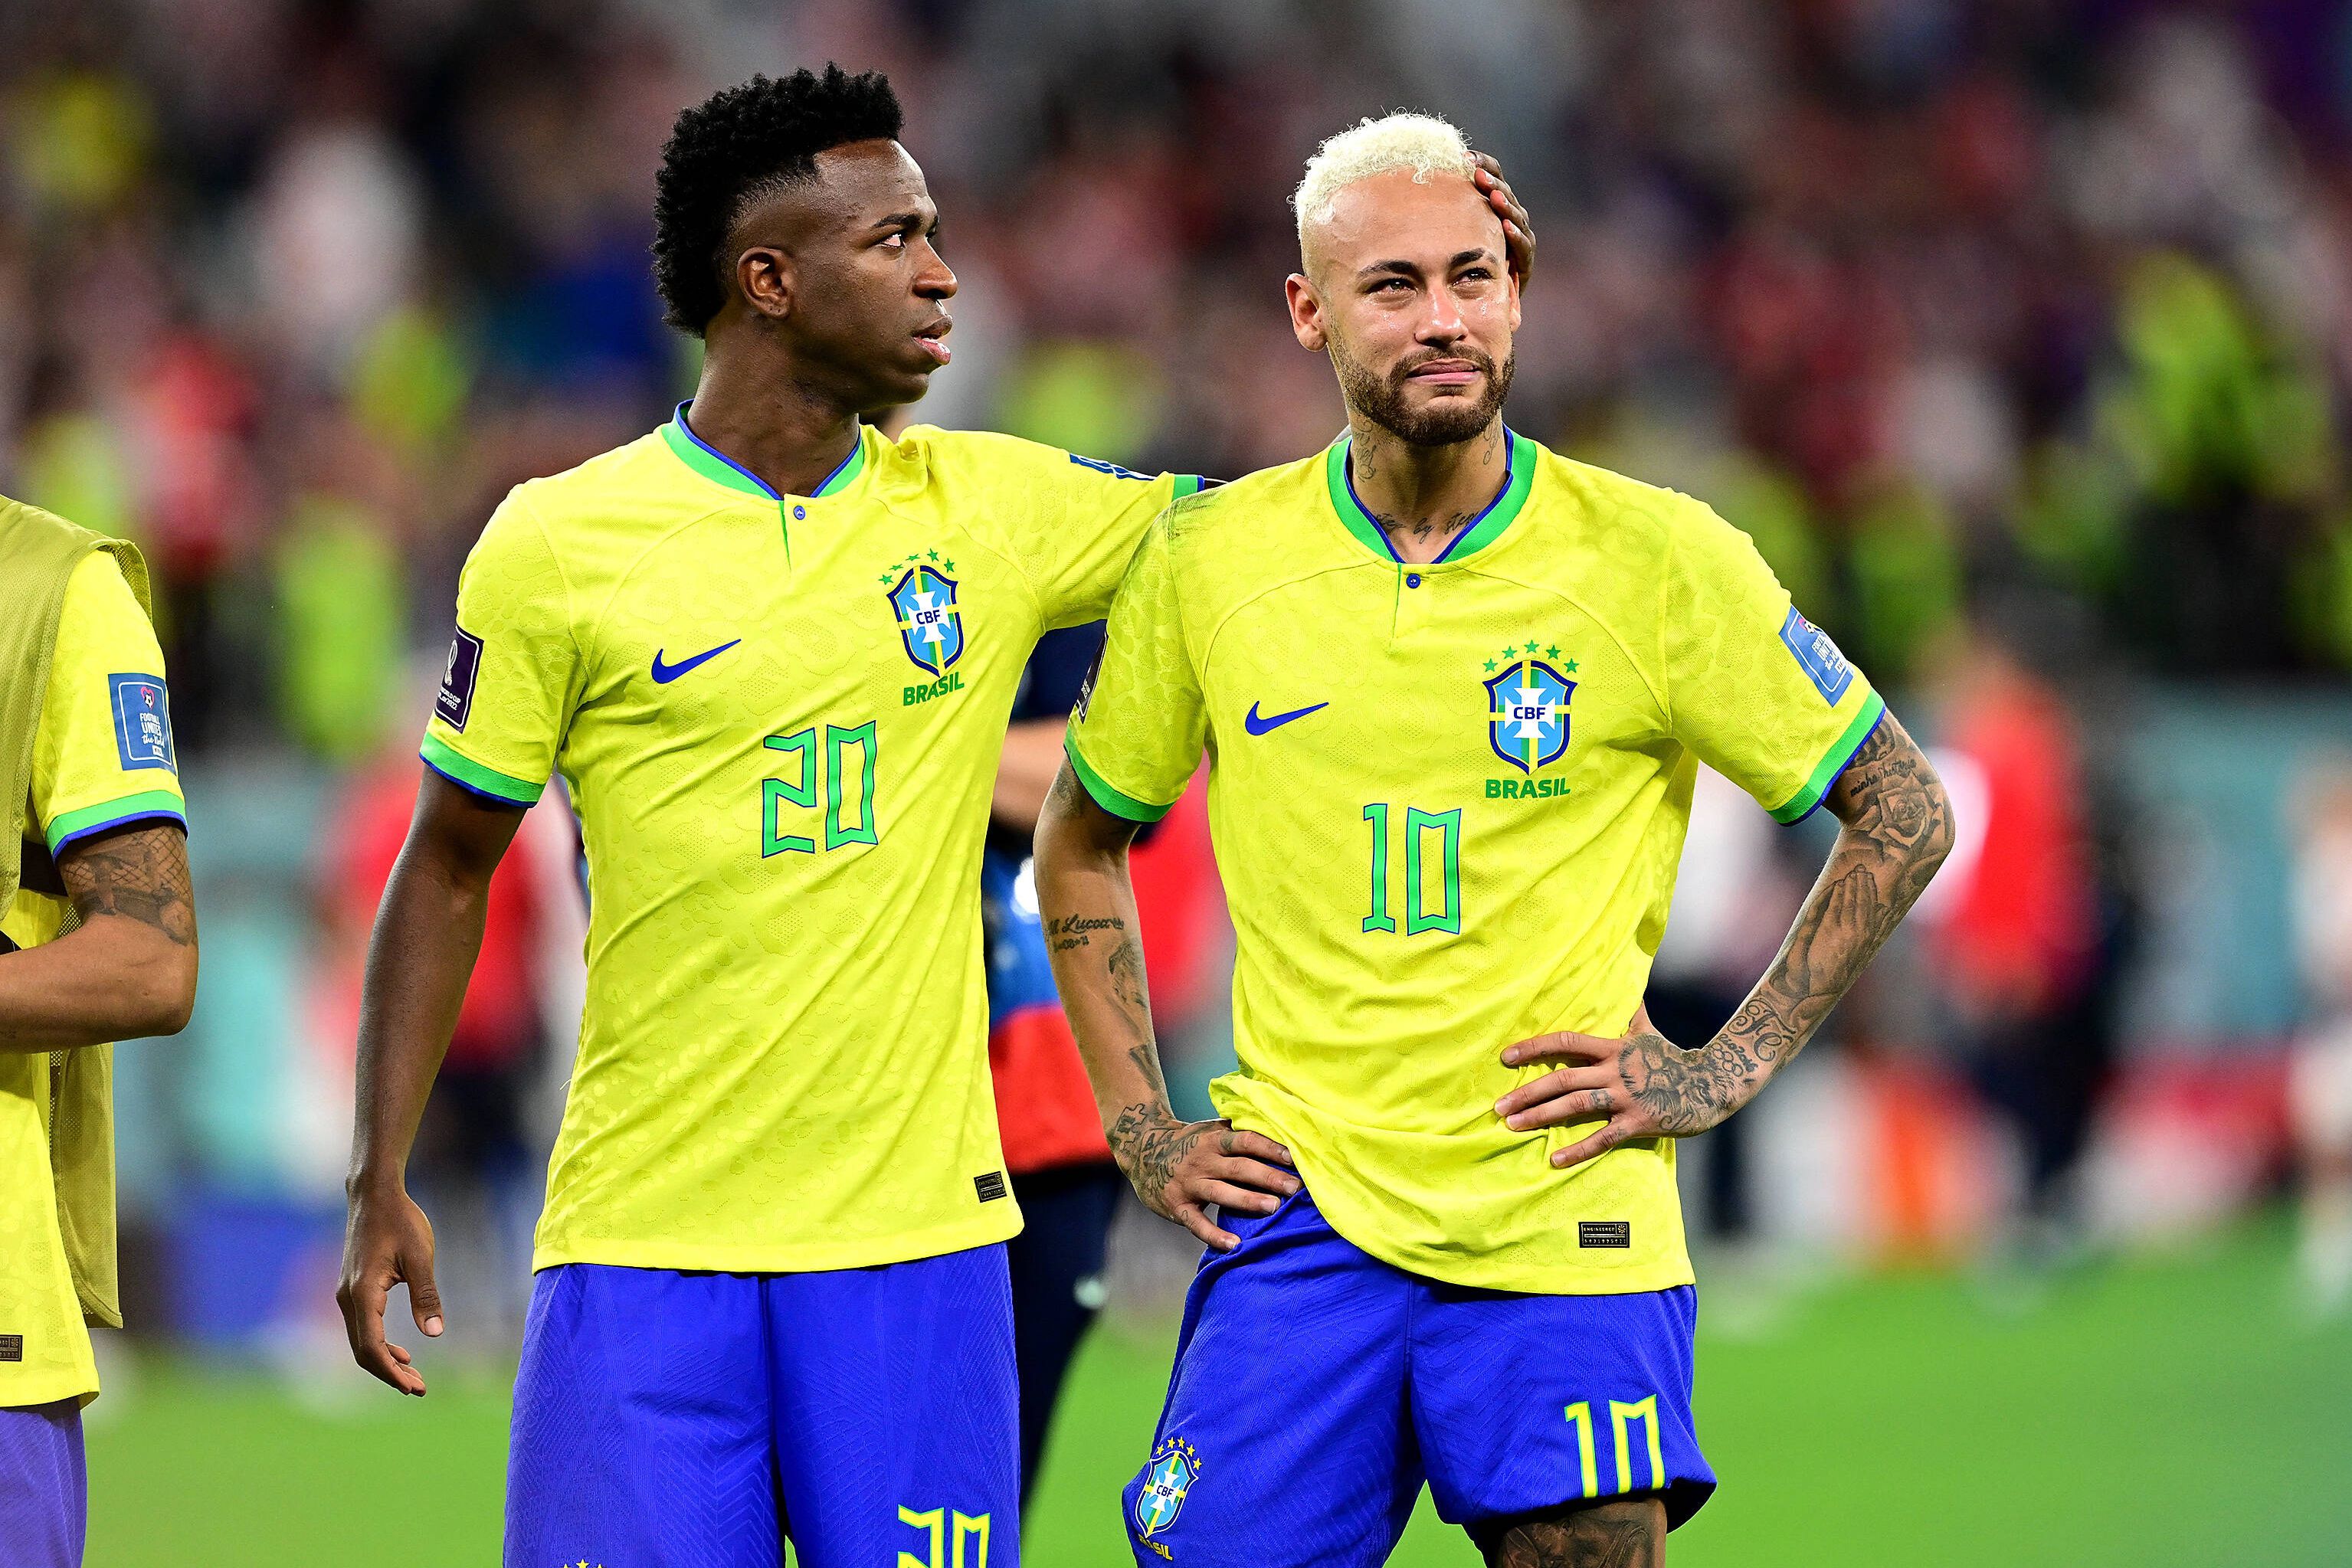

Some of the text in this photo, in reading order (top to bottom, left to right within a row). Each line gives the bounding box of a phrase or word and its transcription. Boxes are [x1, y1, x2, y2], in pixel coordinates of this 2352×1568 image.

[916, 609, 941, 625] CBF
[902, 671, 965, 707] BRASIL
[1513, 706, 1546, 720] CBF
[762, 719, 879, 859] 20
[1485, 777, 1571, 800] BRASIL
[1362, 803, 1462, 936] 10
[1564, 1393, 1666, 1498] 10
[1156, 1485, 1174, 1498] CBF
